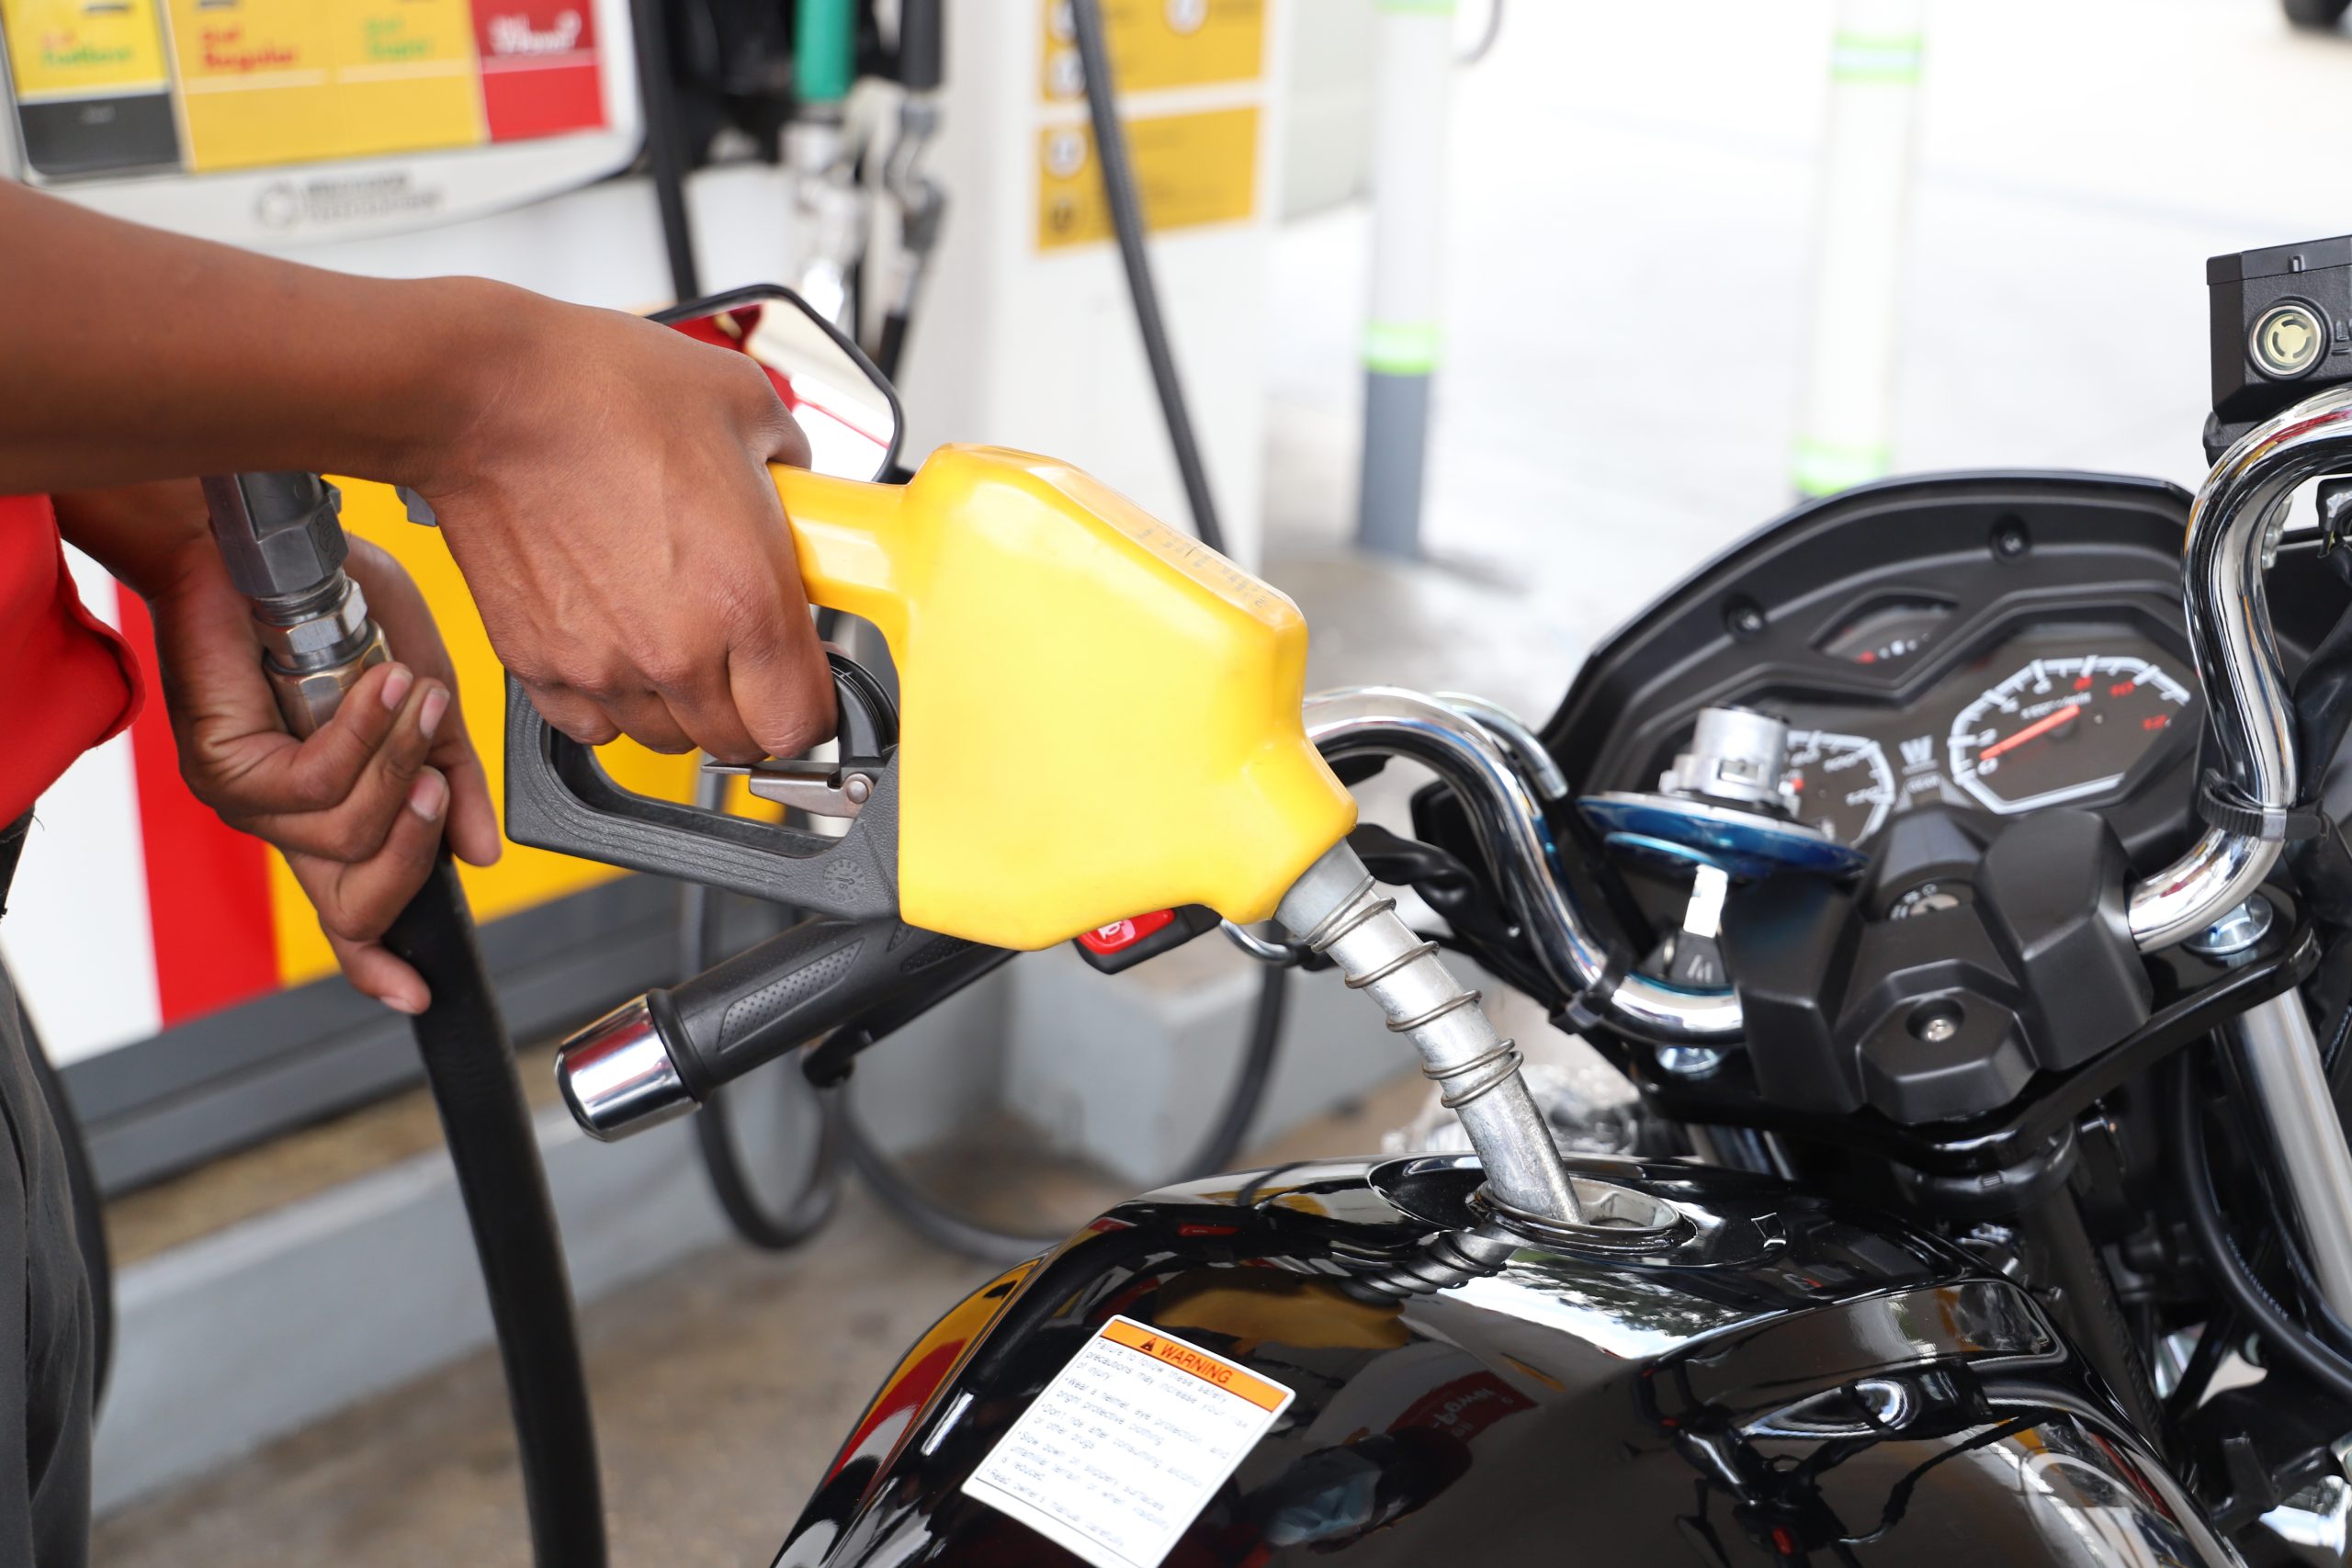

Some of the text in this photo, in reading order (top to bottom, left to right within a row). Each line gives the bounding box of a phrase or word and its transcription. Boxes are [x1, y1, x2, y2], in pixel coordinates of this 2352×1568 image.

[1082, 1350, 1134, 1374] precautions
[1136, 1371, 1157, 1385] may
[1096, 1339, 1125, 1355] Failure
[1138, 1357, 1165, 1372] follow
[1198, 1386, 1228, 1404] safety
[1159, 1343, 1234, 1383] WARNING
[1069, 1377, 1089, 1390] Wear
[1133, 1408, 1152, 1420] eye
[1080, 1401, 1125, 1425] protective
[1021, 1430, 1039, 1446] Slow
[989, 1469, 1012, 1485] Read
